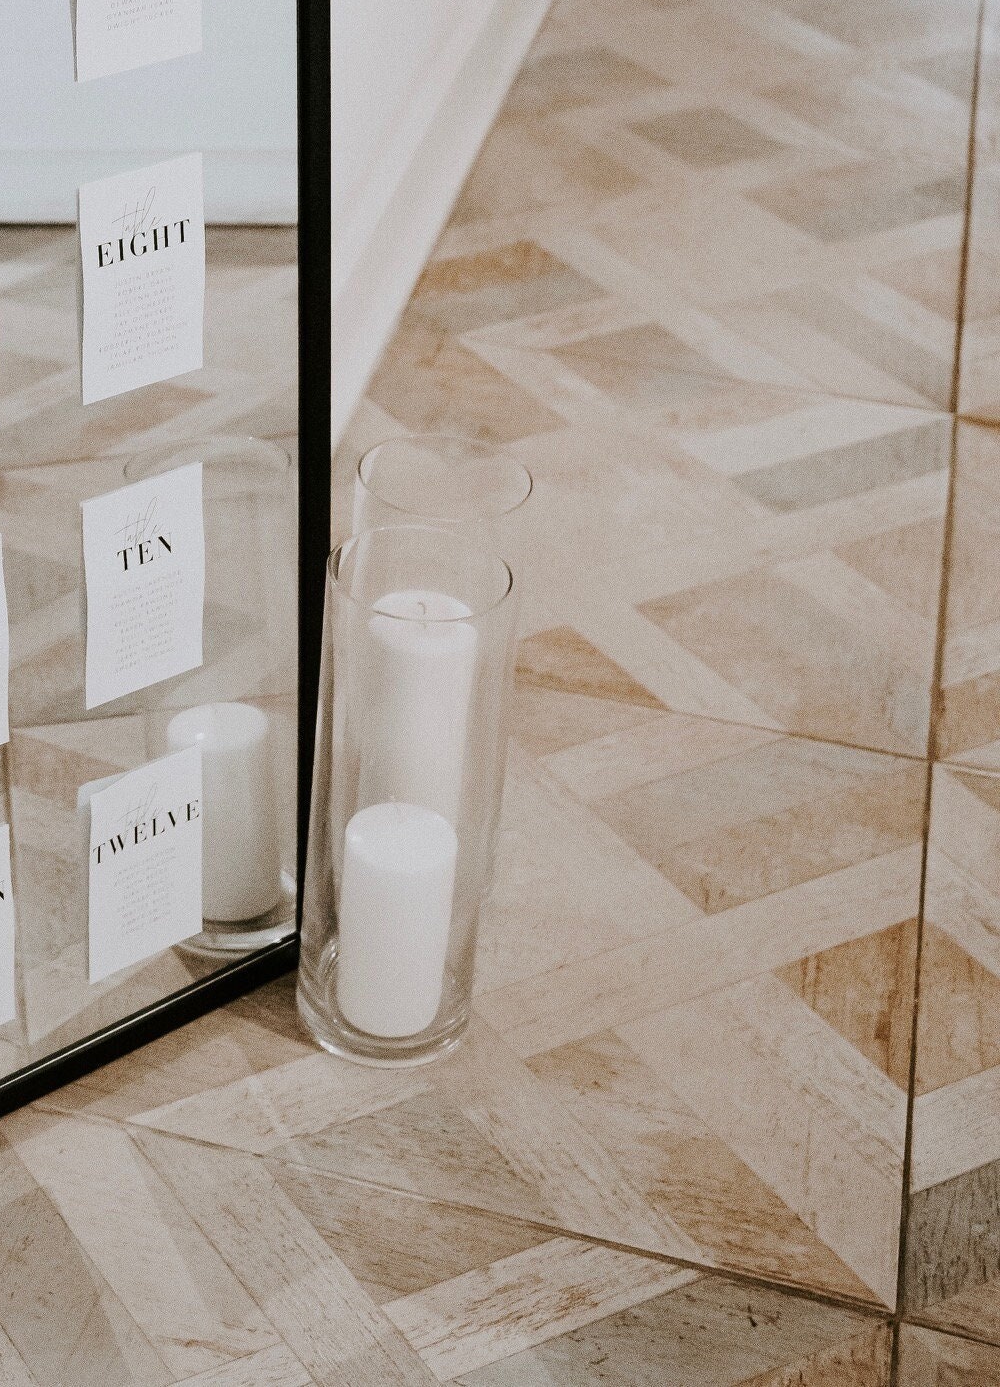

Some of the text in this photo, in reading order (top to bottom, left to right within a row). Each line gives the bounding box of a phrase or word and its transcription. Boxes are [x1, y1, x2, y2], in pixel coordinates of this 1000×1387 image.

[96, 219, 190, 268] EIGHT
[117, 532, 172, 574] TEN
[93, 800, 200, 864] TWELVE
